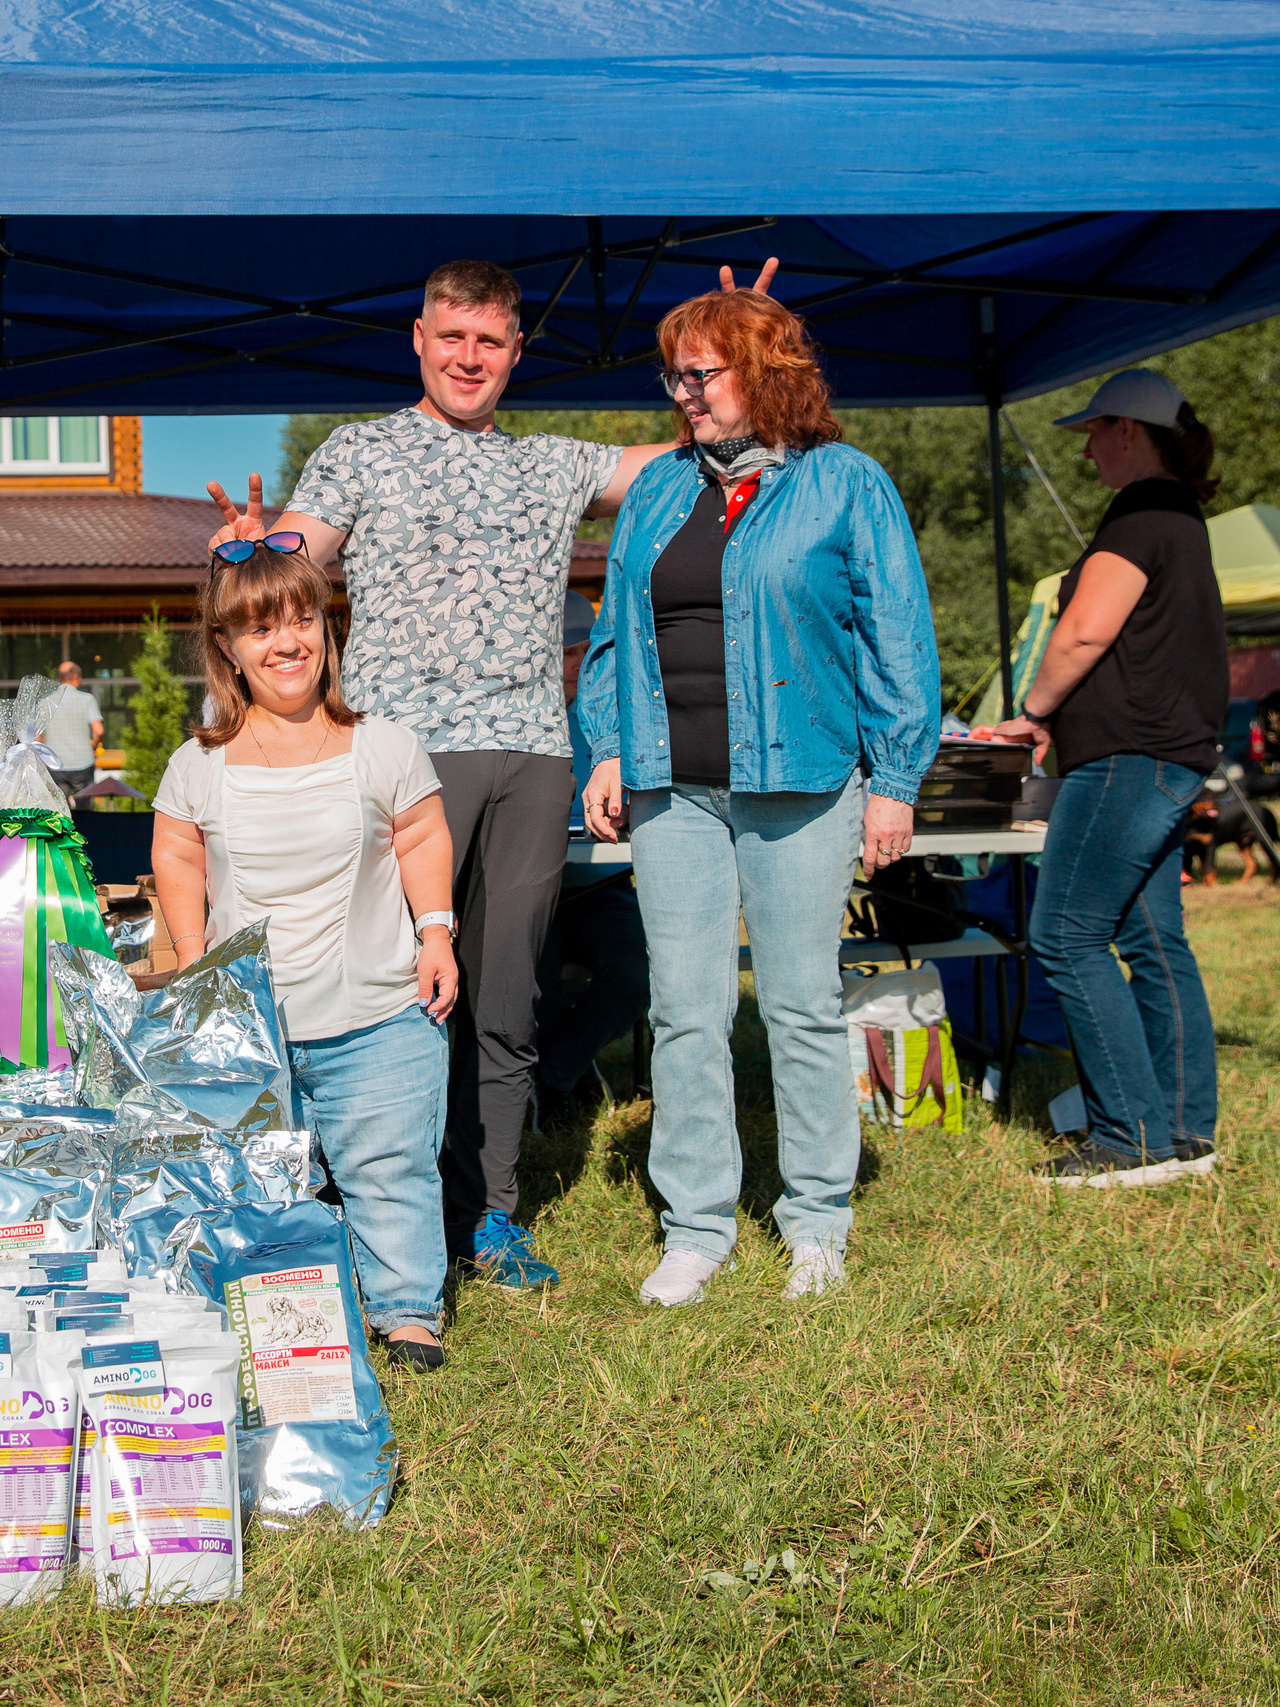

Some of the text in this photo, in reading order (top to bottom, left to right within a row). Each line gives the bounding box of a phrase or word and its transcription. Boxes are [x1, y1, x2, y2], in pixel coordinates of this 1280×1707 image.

[263, 1270, 321, 1284] ЗООМЕНЮ
[227, 1281, 259, 1428] ПРОФЕССИОНАЛ
[254, 1349, 346, 1361] АССОРТИ 24/12
[255, 1359, 290, 1371] МАКСИ
[105, 1421, 176, 1438] COMPLEX
[198, 1539, 227, 1551] 1000 г.
[38, 1557, 60, 1569] 1000
